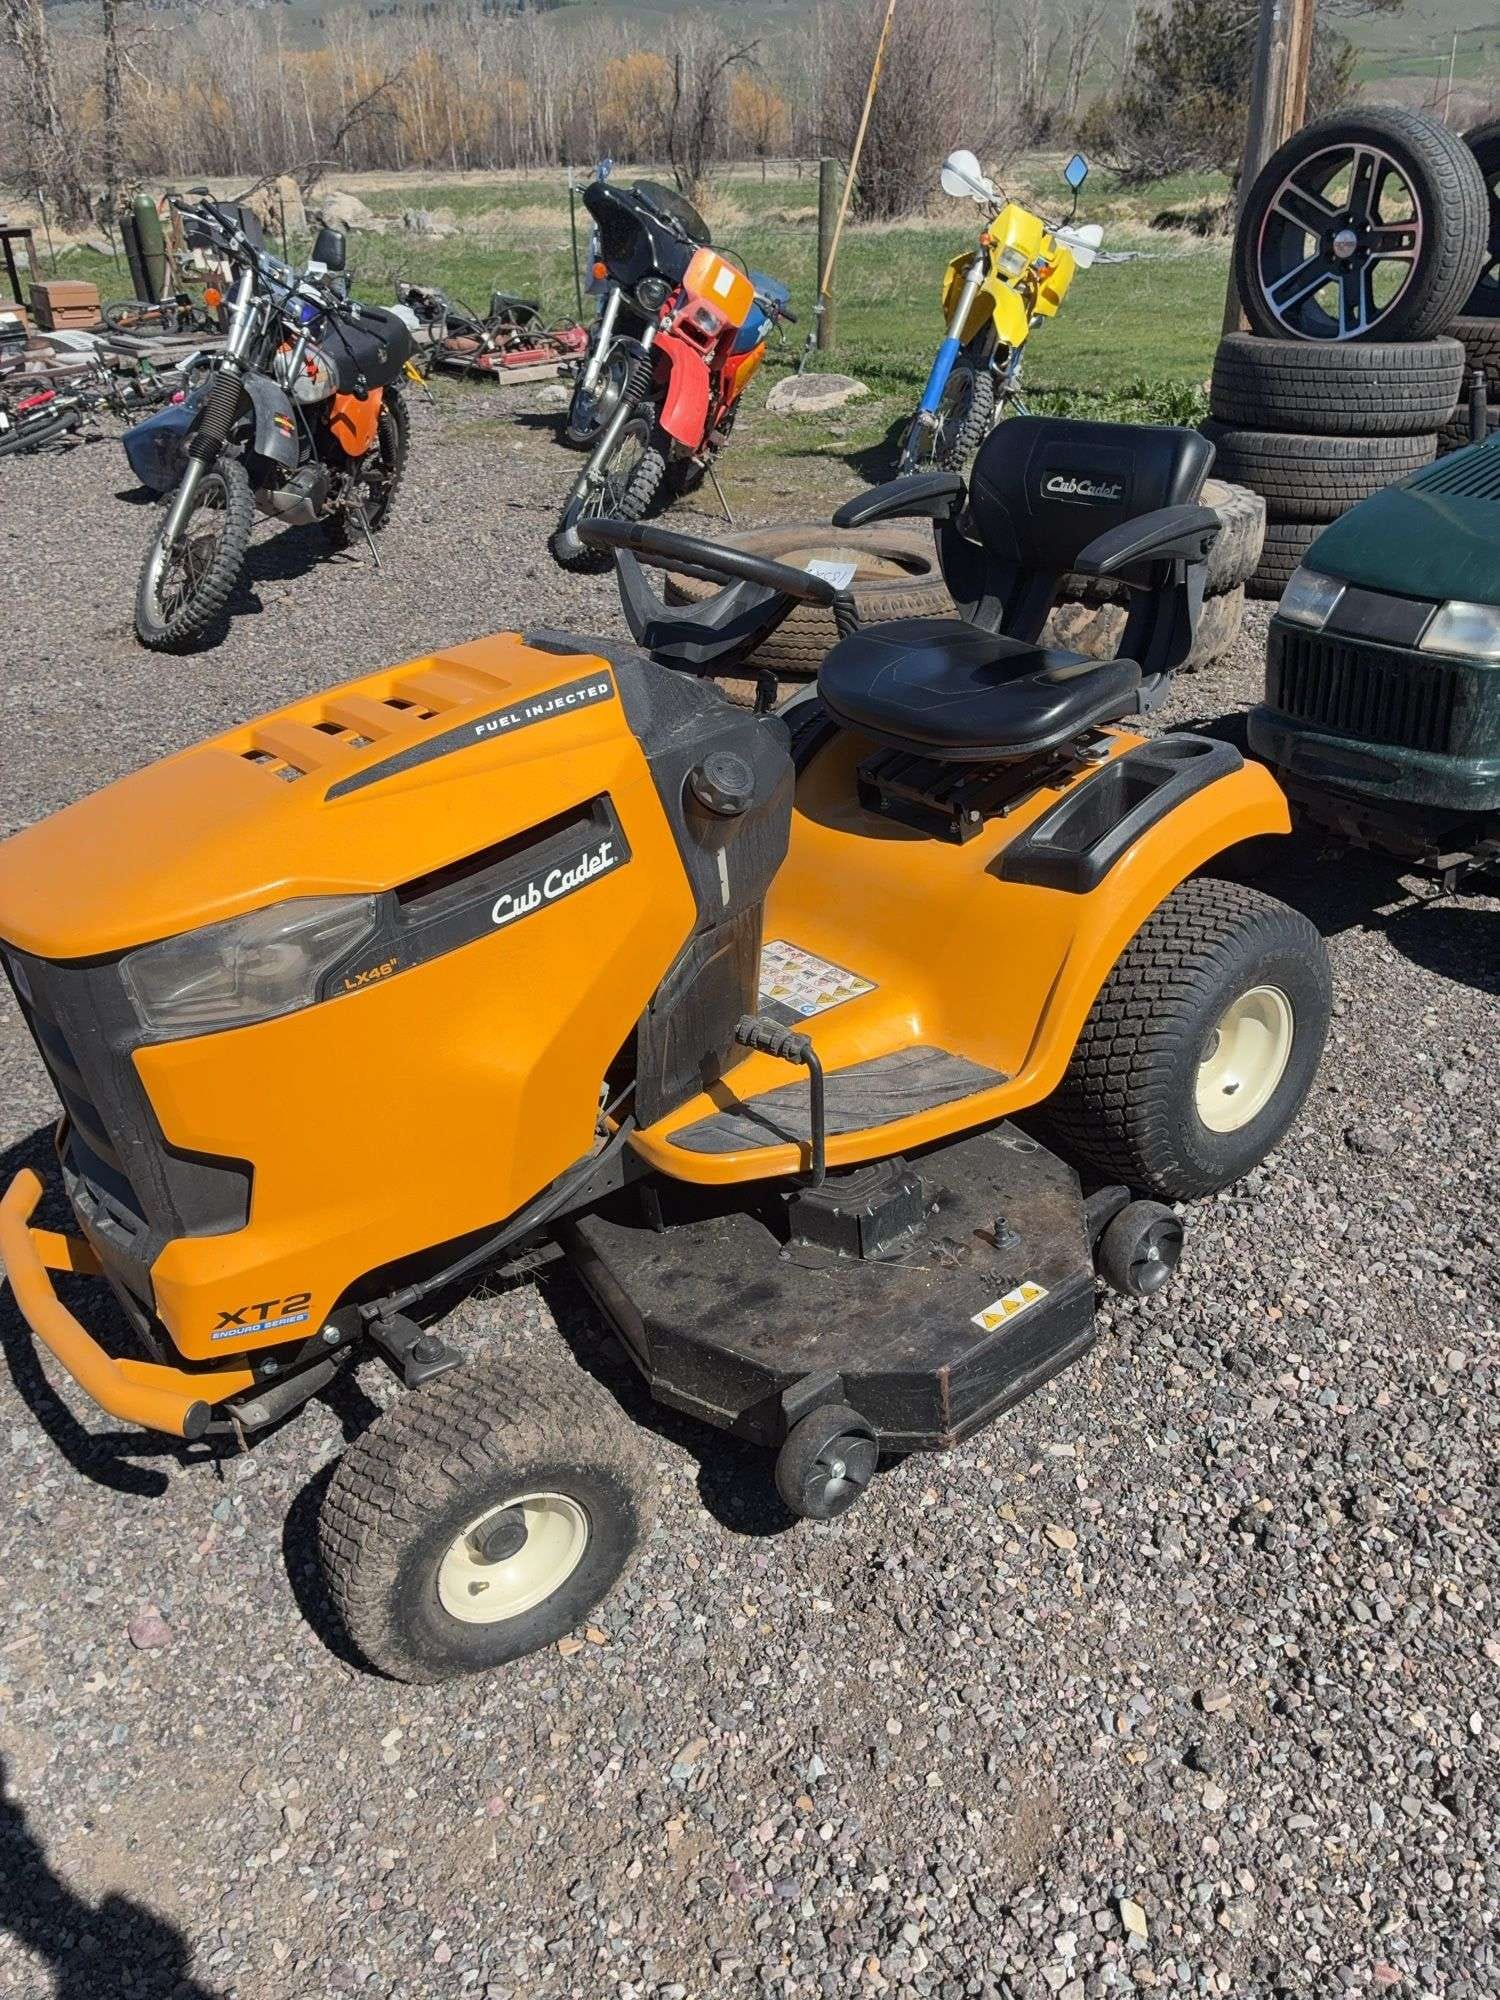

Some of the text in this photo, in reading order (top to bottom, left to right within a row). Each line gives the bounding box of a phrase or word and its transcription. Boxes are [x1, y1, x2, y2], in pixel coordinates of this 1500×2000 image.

[1046, 476, 1122, 499] Cub Cadet
[474, 683, 609, 735] FUEL INJECTED
[491, 842, 615, 924] Cub Cadet
[212, 1292, 312, 1330] XT2
[212, 1314, 304, 1339] ENDURO SERIES
